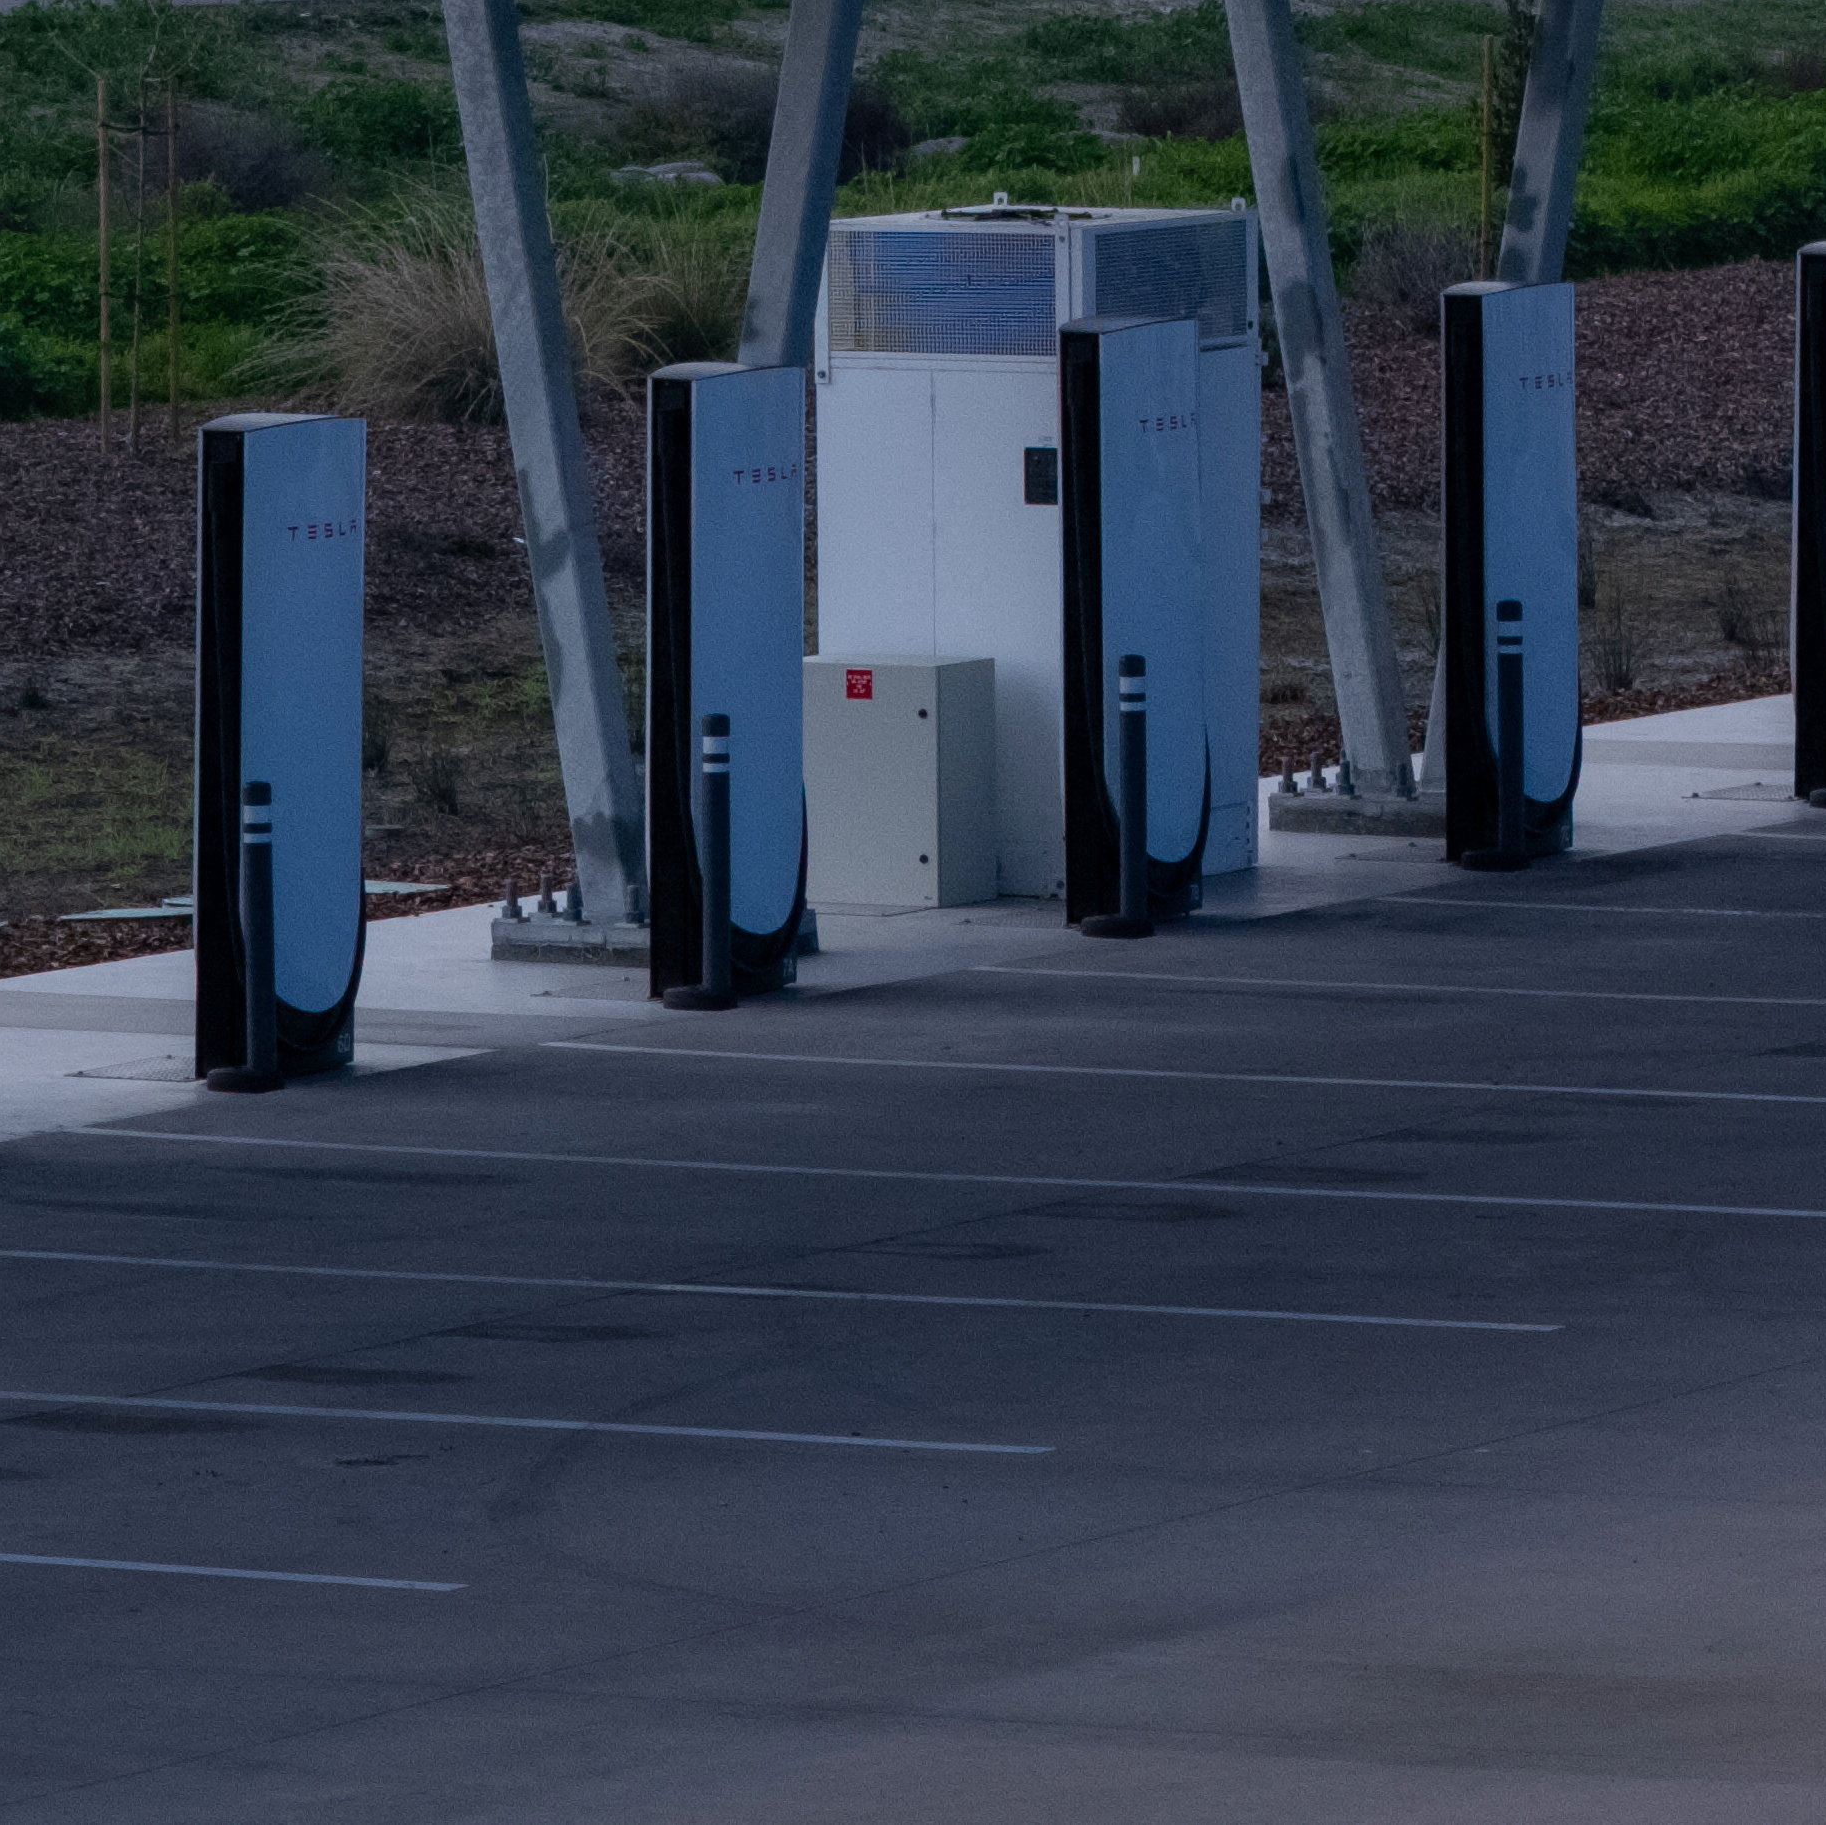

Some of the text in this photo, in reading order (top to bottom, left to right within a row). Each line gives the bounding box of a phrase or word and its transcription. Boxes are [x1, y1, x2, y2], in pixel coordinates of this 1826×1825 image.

[1140, 413, 1196, 432] TESLA
[733, 463, 797, 484] TESLA
[288, 519, 358, 540] TESLA
